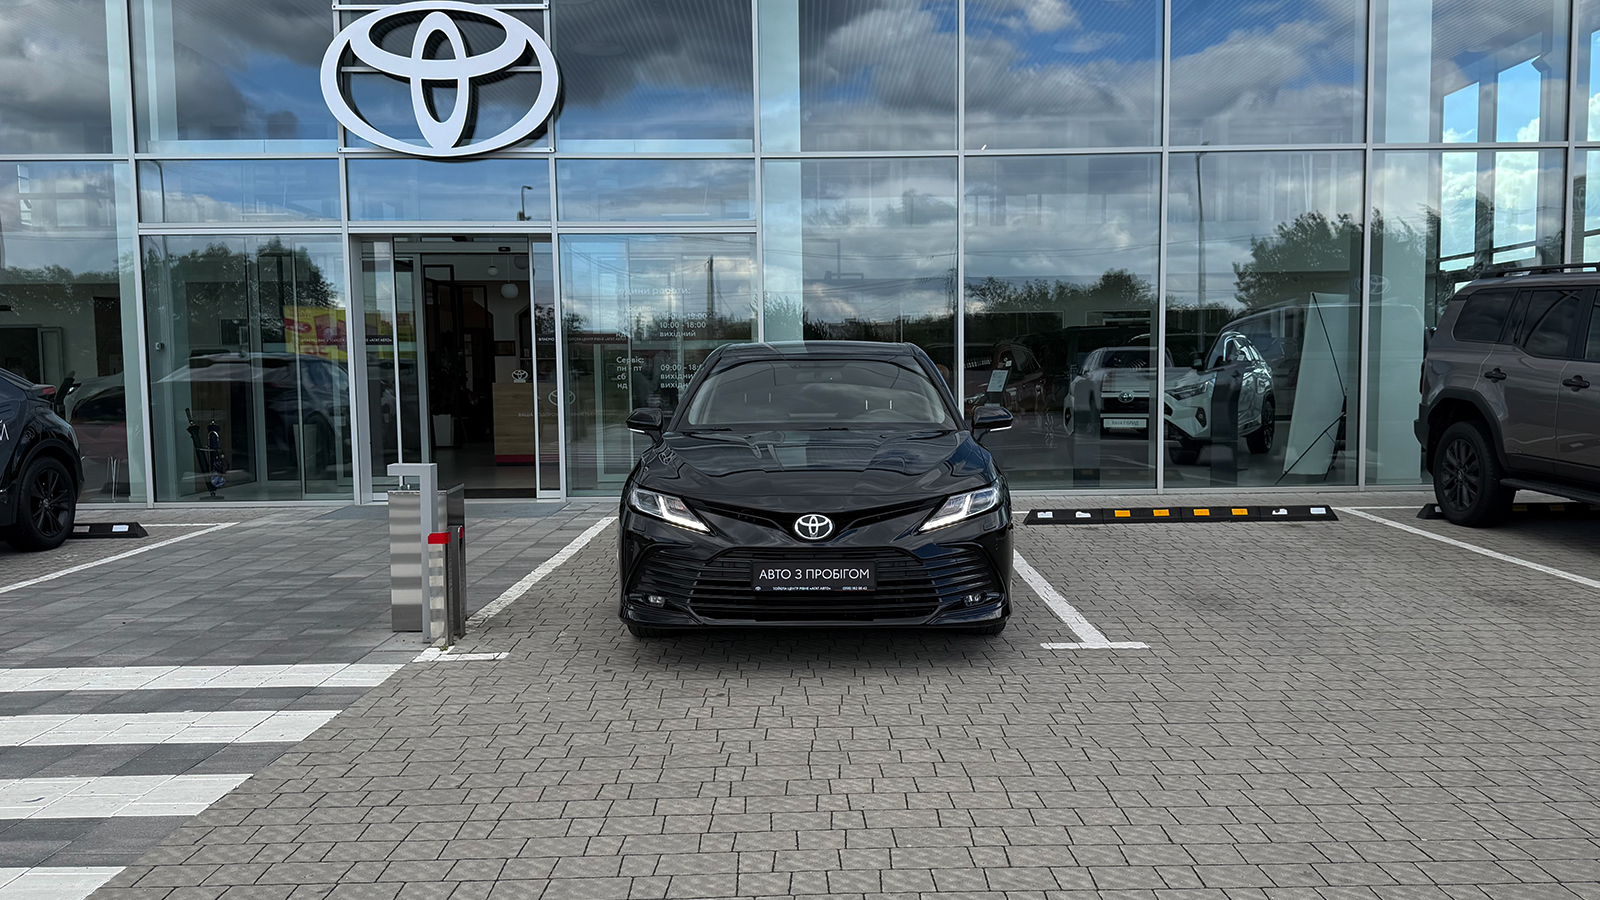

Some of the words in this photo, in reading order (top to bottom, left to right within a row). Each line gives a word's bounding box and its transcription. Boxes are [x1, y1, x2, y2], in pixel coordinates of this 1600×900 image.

[687, 312, 708, 320] 19:00
[660, 321, 680, 329] 10:00
[687, 321, 706, 329] 18:00
[659, 330, 696, 338] вихідний
[616, 356, 645, 364] Сервіс:
[759, 569, 791, 579] АВТО
[795, 569, 802, 579] З
[806, 569, 869, 579] ПРОБІГОМ
